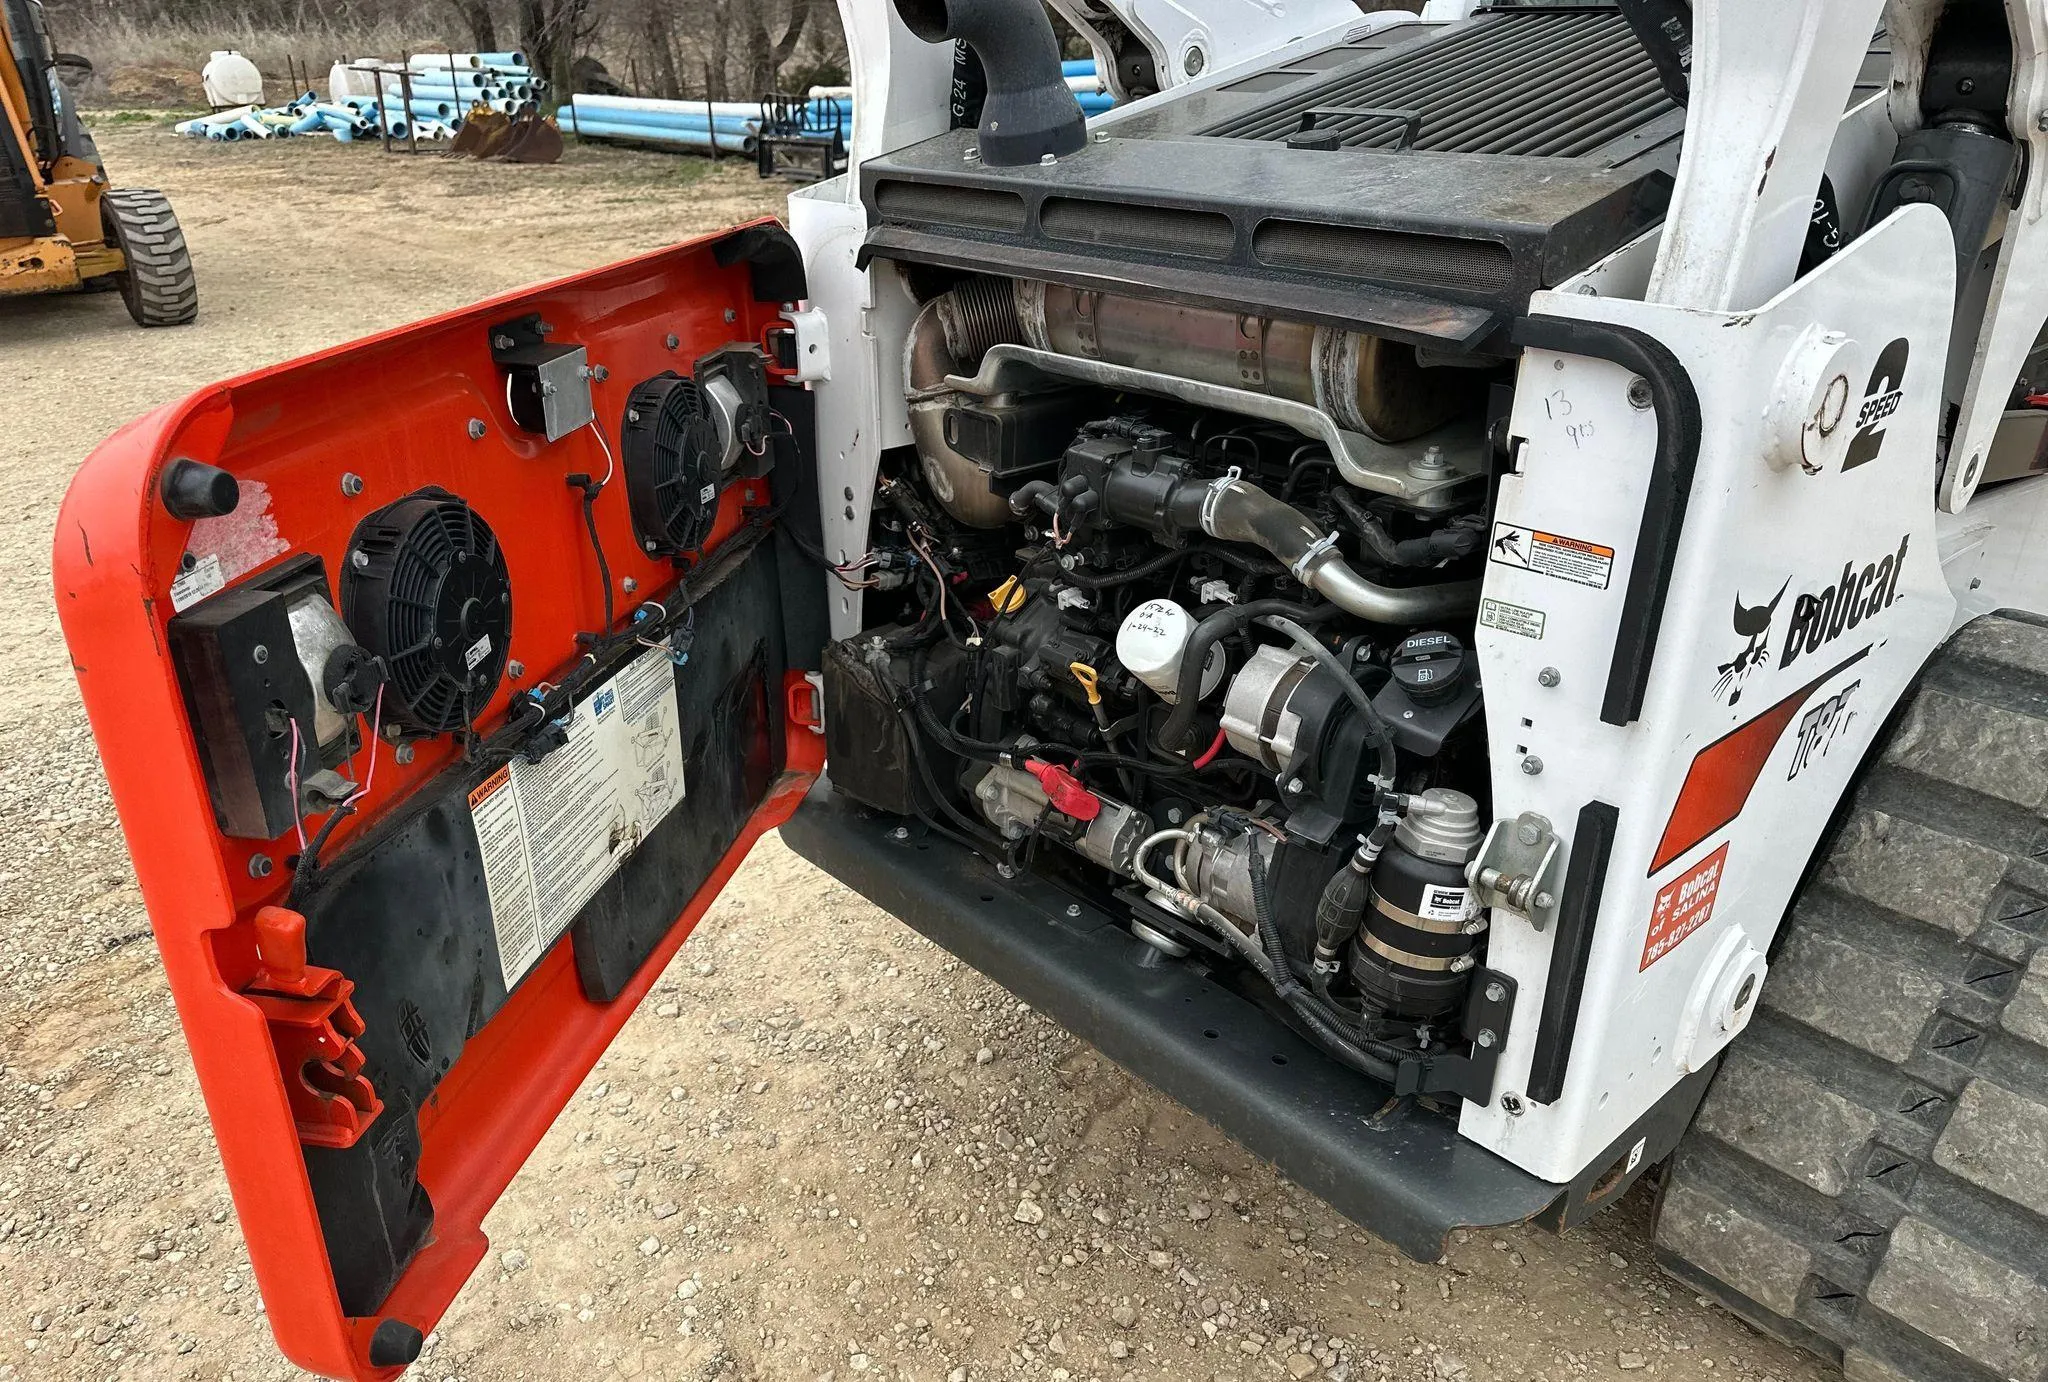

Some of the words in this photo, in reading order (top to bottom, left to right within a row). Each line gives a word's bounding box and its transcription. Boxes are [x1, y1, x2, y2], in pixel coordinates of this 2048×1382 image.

[1544, 389, 1573, 420] 13
[1855, 390, 1904, 429] SPEED
[1559, 539, 1593, 552] WARNING
[1778, 532, 1911, 671] Bobcat
[1406, 635, 1452, 648] DIESEL
[477, 769, 508, 800] WARNING
[1679, 859, 1720, 905] Bobcat
[1672, 880, 1716, 922] SALINA
